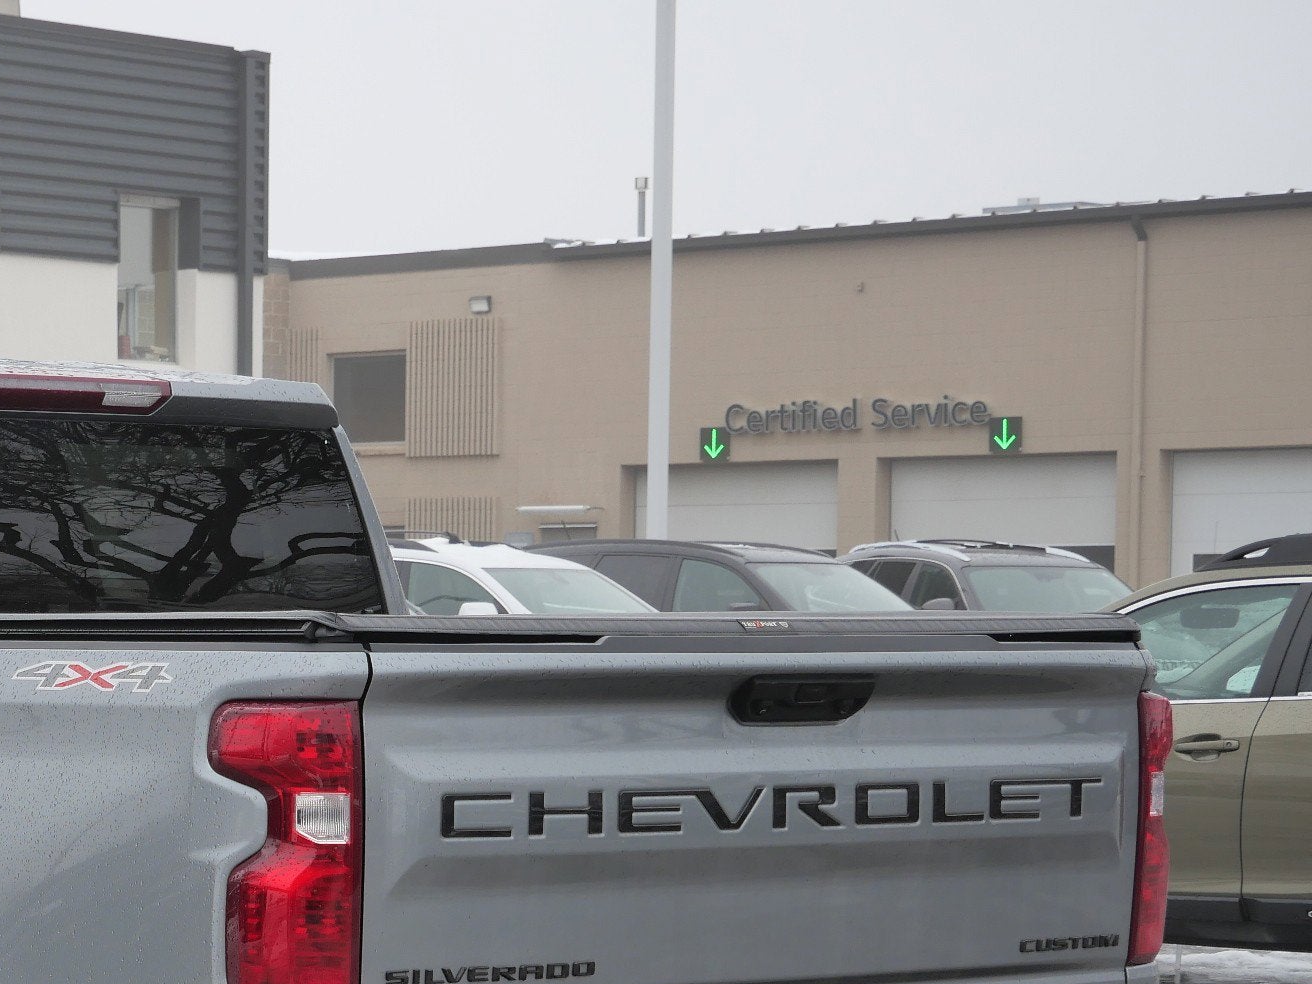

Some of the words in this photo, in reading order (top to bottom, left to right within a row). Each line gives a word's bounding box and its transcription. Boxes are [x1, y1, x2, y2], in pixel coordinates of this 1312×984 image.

[725, 398, 859, 434] Certified
[871, 395, 989, 430] Service
[439, 778, 1103, 839] CHEVROLET
[1019, 934, 1119, 953] CUSTOM
